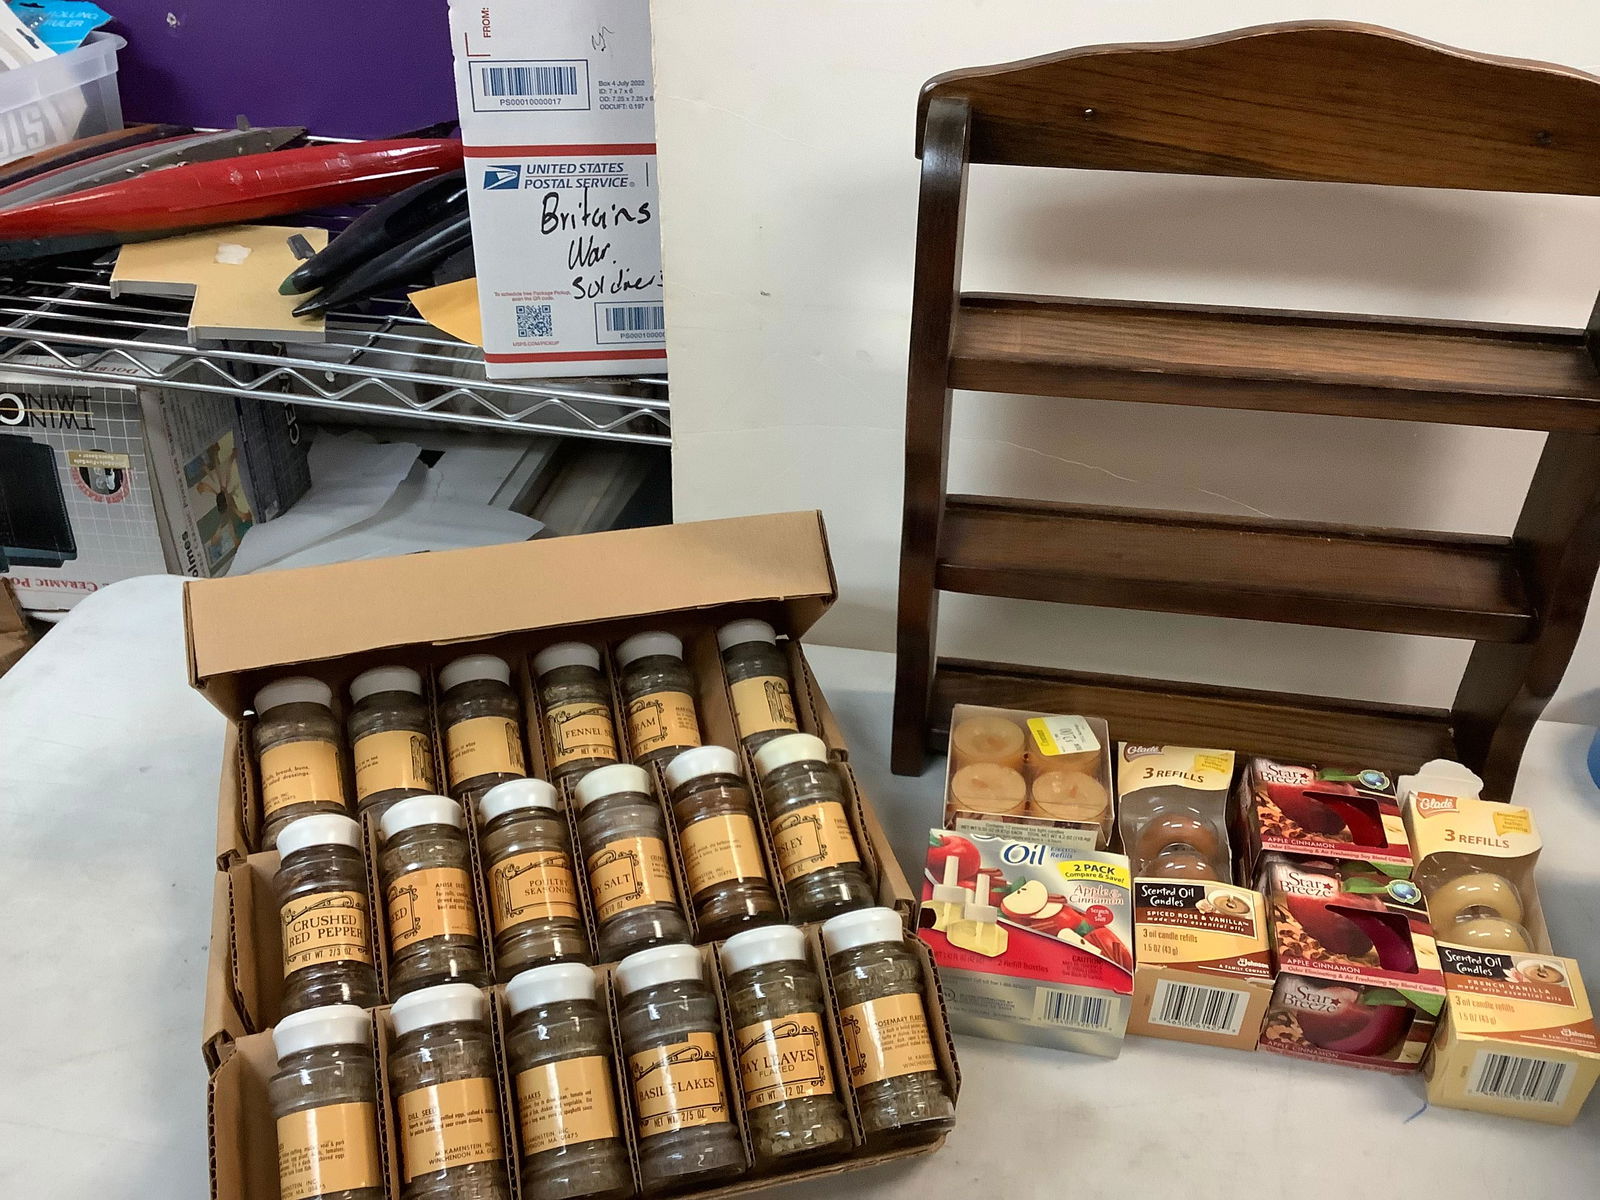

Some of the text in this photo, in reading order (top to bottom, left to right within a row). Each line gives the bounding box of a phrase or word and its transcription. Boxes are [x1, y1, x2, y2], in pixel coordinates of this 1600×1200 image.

[481, 7, 491, 38] FROM:
[500, 98, 562, 107] PS00010000017
[526, 162, 624, 174] UNITED STATES
[524, 178, 573, 189] POSTAL
[566, 728, 602, 738] FENNEL
[1142, 768, 1205, 784] 3 REFILLS
[1260, 771, 1309, 786] Breeze
[1268, 764, 1300, 779] Star
[1268, 836, 1336, 850] APPLE CINNAMON
[1444, 828, 1510, 849] 3 REFILLS
[1004, 844, 1047, 865] Oil
[1074, 864, 1116, 875] 2 PACK
[604, 874, 630, 890] SALT
[1064, 872, 1096, 880] Compare
[1105, 874, 1125, 884] Save!
[1288, 872, 1322, 888] Star
[1074, 884, 1108, 898] Apple
[1142, 884, 1195, 899] Scented Oil
[1280, 880, 1333, 898] Breeze
[1069, 895, 1124, 906] Cinnamon
[1150, 896, 1185, 908] Candles
[1146, 910, 1176, 918] SPICED
[1178, 912, 1199, 920] ROSE
[294, 914, 357, 932] CRUSHED
[1190, 920, 1228, 929] essential
[289, 926, 364, 949] RED PEPPER
[1142, 928, 1198, 943] 3 oil candle refills
[302, 953, 311, 962] NET
[315, 951, 324, 959] WT
[1445, 950, 1502, 968] Scented Oil
[1286, 958, 1361, 974] APPLE CINNAMON
[1456, 962, 1494, 978] Candles
[1388, 980, 1400, 988] Soy
[1467, 979, 1551, 995] FRENCH VANILLA
[1296, 985, 1332, 1004] Star
[1482, 986, 1500, 994] with
[1504, 989, 1544, 1000] essential
[1283, 992, 1336, 1012] Breeze
[1455, 995, 1462, 1006] 3
[1462, 998, 1471, 1007] oil
[1472, 998, 1494, 1010] candle
[1292, 1045, 1340, 1059] CINNAMON
[654, 1114, 664, 1126] NET
